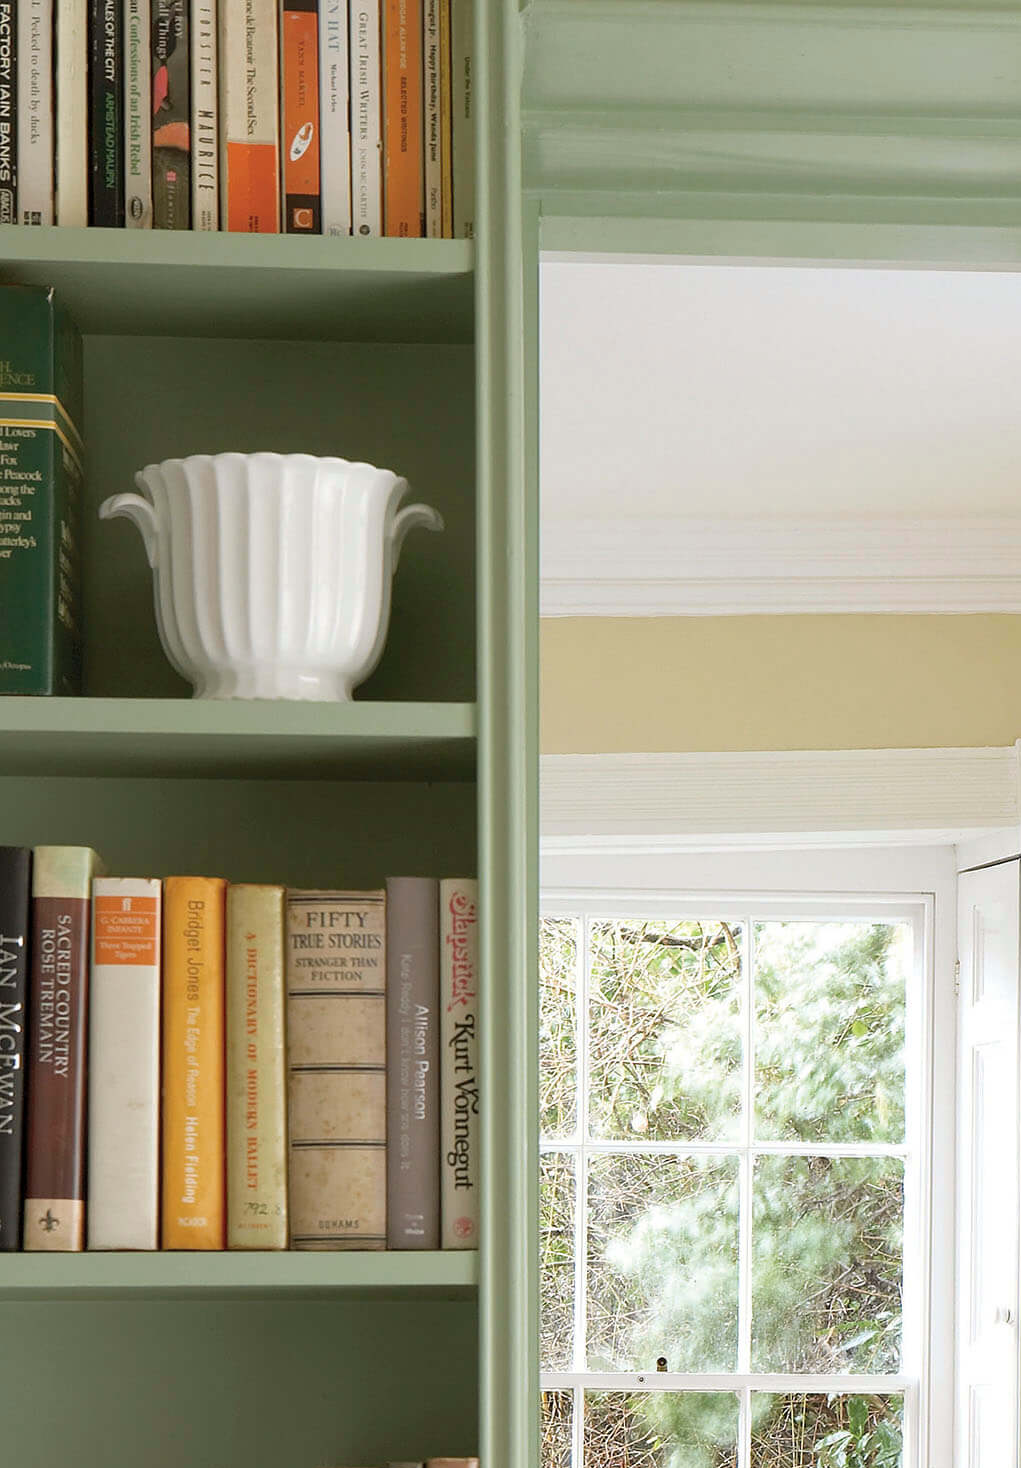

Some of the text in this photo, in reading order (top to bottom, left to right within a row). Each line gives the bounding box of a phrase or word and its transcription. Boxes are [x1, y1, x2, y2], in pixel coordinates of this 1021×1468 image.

[104, 0, 115, 21] ALES
[104, 22, 115, 37] OF
[31, 17, 41, 51] Pecked
[104, 38, 115, 57] THE
[155, 20, 169, 59] Things
[31, 69, 41, 96] death
[104, 58, 115, 82] CITY
[0, 4, 11, 181] FACTORY IAIN BANKS
[130, 15, 141, 175] Confessions of an Irish Rebel
[198, 110, 215, 191] MAURICE
[183, 900, 205, 951] Bridget
[306, 911, 369, 928] FIFTY
[0, 933, 24, 988] IAN
[292, 933, 382, 949] TRUE STORIES
[187, 957, 204, 1001] Jones
[295, 957, 347, 968] STRANGER
[311, 971, 363, 981] FICTION
[39, 929, 56, 1063] ROSE TREMAIN
[54, 915, 72, 1078] SACRED COUNTRY
[247, 948, 257, 1037] DICTIONARY
[187, 1007, 200, 1024] The
[247, 1043, 257, 1062] OF
[446, 892, 479, 1190] Slapstick Kurt Vonnegut
[414, 1004, 429, 1120] Allison Pearson
[247, 1069, 257, 1130] MODERN
[185, 1116, 198, 1151] Helen
[181, 1155, 198, 1204] Fielding
[247, 1137, 257, 1191] BALLET
